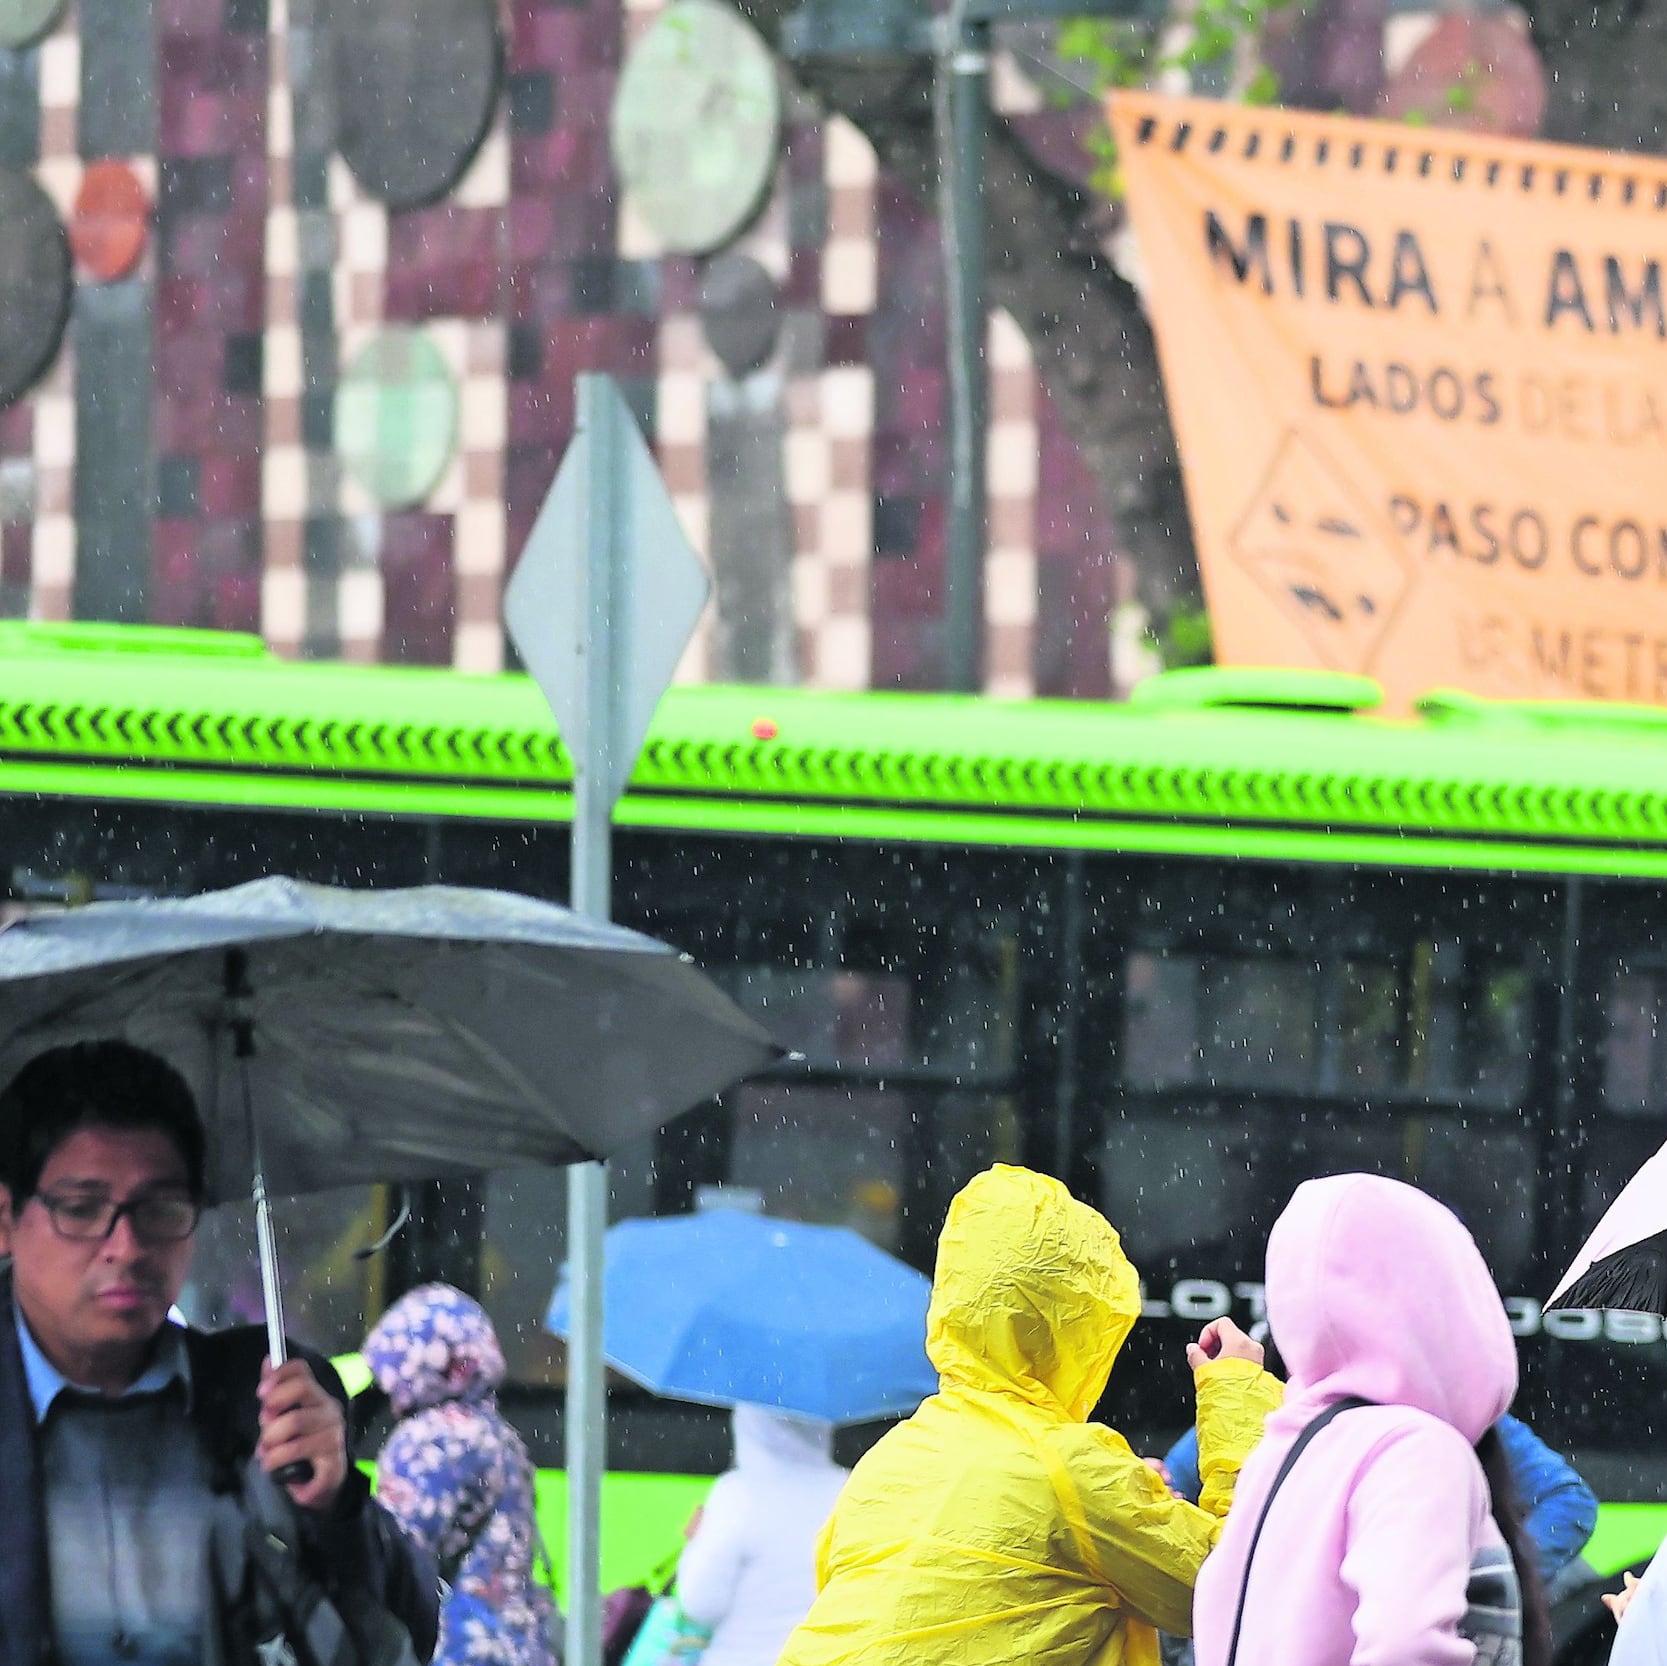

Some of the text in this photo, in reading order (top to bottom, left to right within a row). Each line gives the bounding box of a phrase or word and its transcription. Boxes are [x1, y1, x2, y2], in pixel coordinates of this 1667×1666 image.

[1205, 211, 1438, 316] MIRA
[1467, 238, 1513, 323] A
[1311, 354, 1501, 425] LADOS
[1391, 494, 1549, 570] PASO
